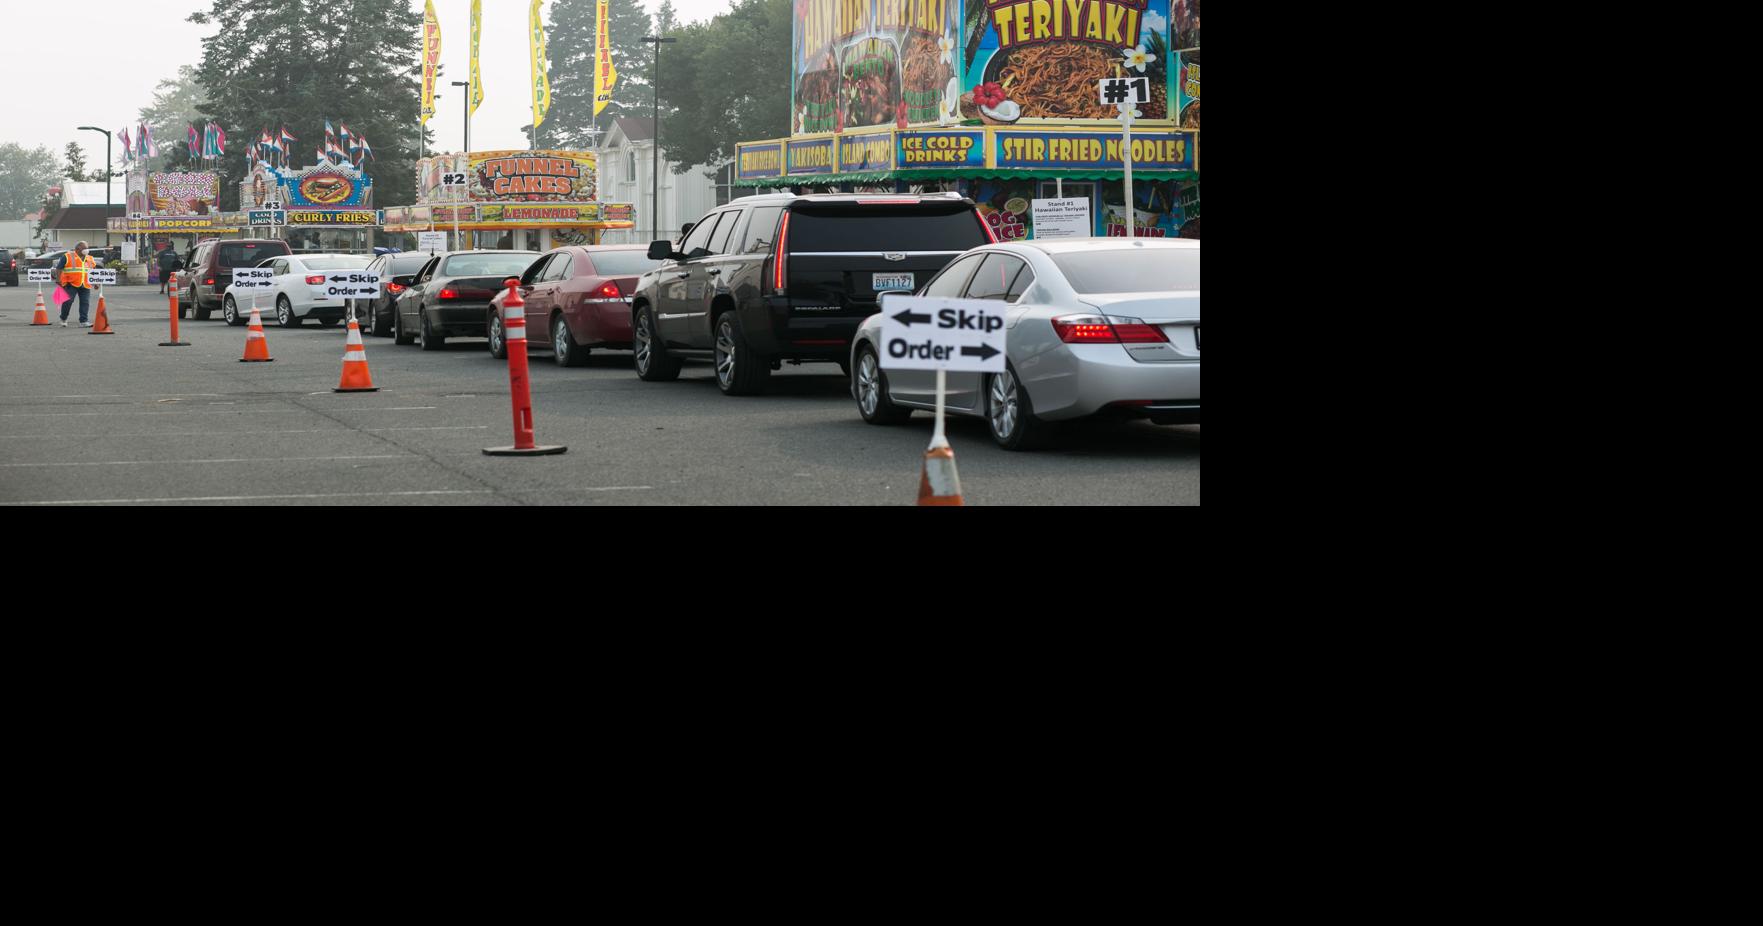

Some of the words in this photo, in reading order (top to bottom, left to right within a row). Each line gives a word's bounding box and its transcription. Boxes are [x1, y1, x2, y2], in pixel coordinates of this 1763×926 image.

[993, 0, 1139, 48] TERIYAKI
[1103, 77, 1149, 104] #1
[902, 137, 923, 150] ICE
[927, 136, 974, 150] COLD
[1002, 137, 1046, 162] STIR
[1049, 138, 1103, 162] FRIED
[1105, 138, 1186, 163] NOODLES
[790, 144, 832, 168] YAKISOBA
[842, 141, 865, 165] ISLAND
[866, 139, 890, 164] COMBO
[905, 149, 967, 163] DRINKS
[485, 157, 580, 178] FUNNEL
[442, 173, 466, 185] #2
[493, 176, 573, 195] CAKES
[264, 201, 280, 210] #3
[502, 207, 579, 219] LEMONADE
[294, 213, 333, 222] CURLY
[335, 213, 370, 222] FRIES
[987, 210, 1017, 227] OG
[1106, 222, 1167, 237] LEMNADE
[250, 270, 273, 279] Skip
[349, 274, 379, 284] Skip
[234, 280, 257, 288] Order
[328, 286, 358, 296] Order
[937, 308, 1004, 333] Skip
[888, 338, 955, 361] Order
